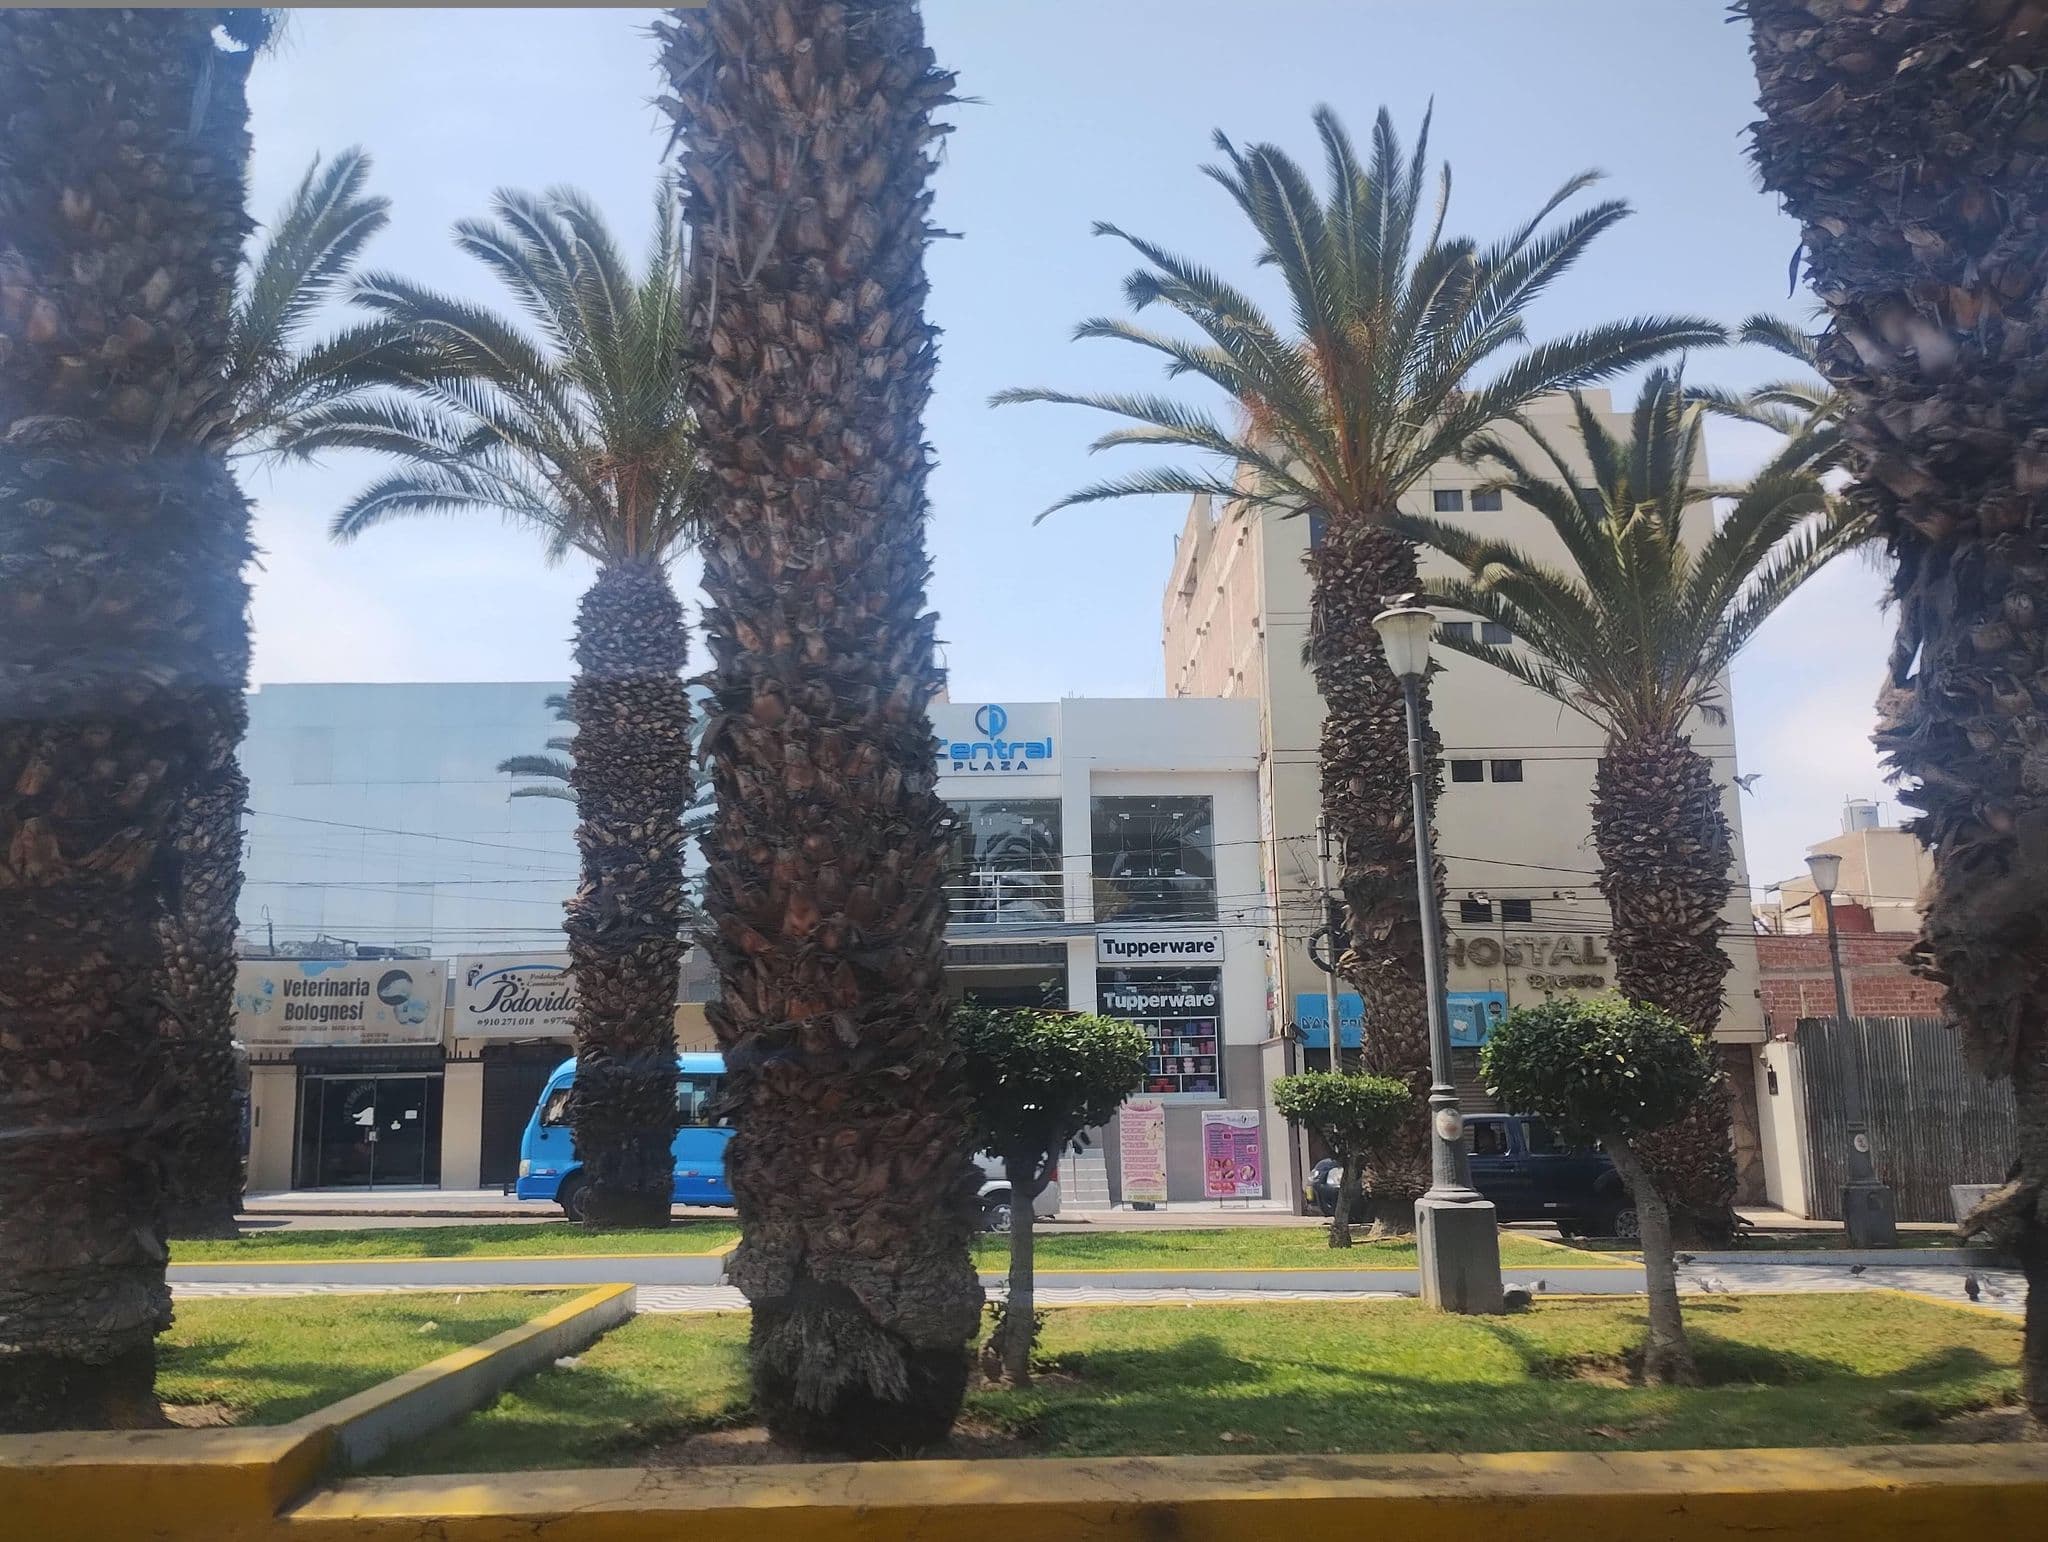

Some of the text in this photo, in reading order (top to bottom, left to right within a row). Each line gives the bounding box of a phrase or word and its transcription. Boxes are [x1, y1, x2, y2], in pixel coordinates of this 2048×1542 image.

[953, 760, 1028, 771] PLAZA
[1103, 939, 1215, 957] Tupperware
[283, 977, 370, 998] Veterinaria
[1103, 992, 1216, 1011] Tupperware
[284, 1001, 364, 1023] Bolognesi
[483, 1017, 535, 1026] 910 271 018
